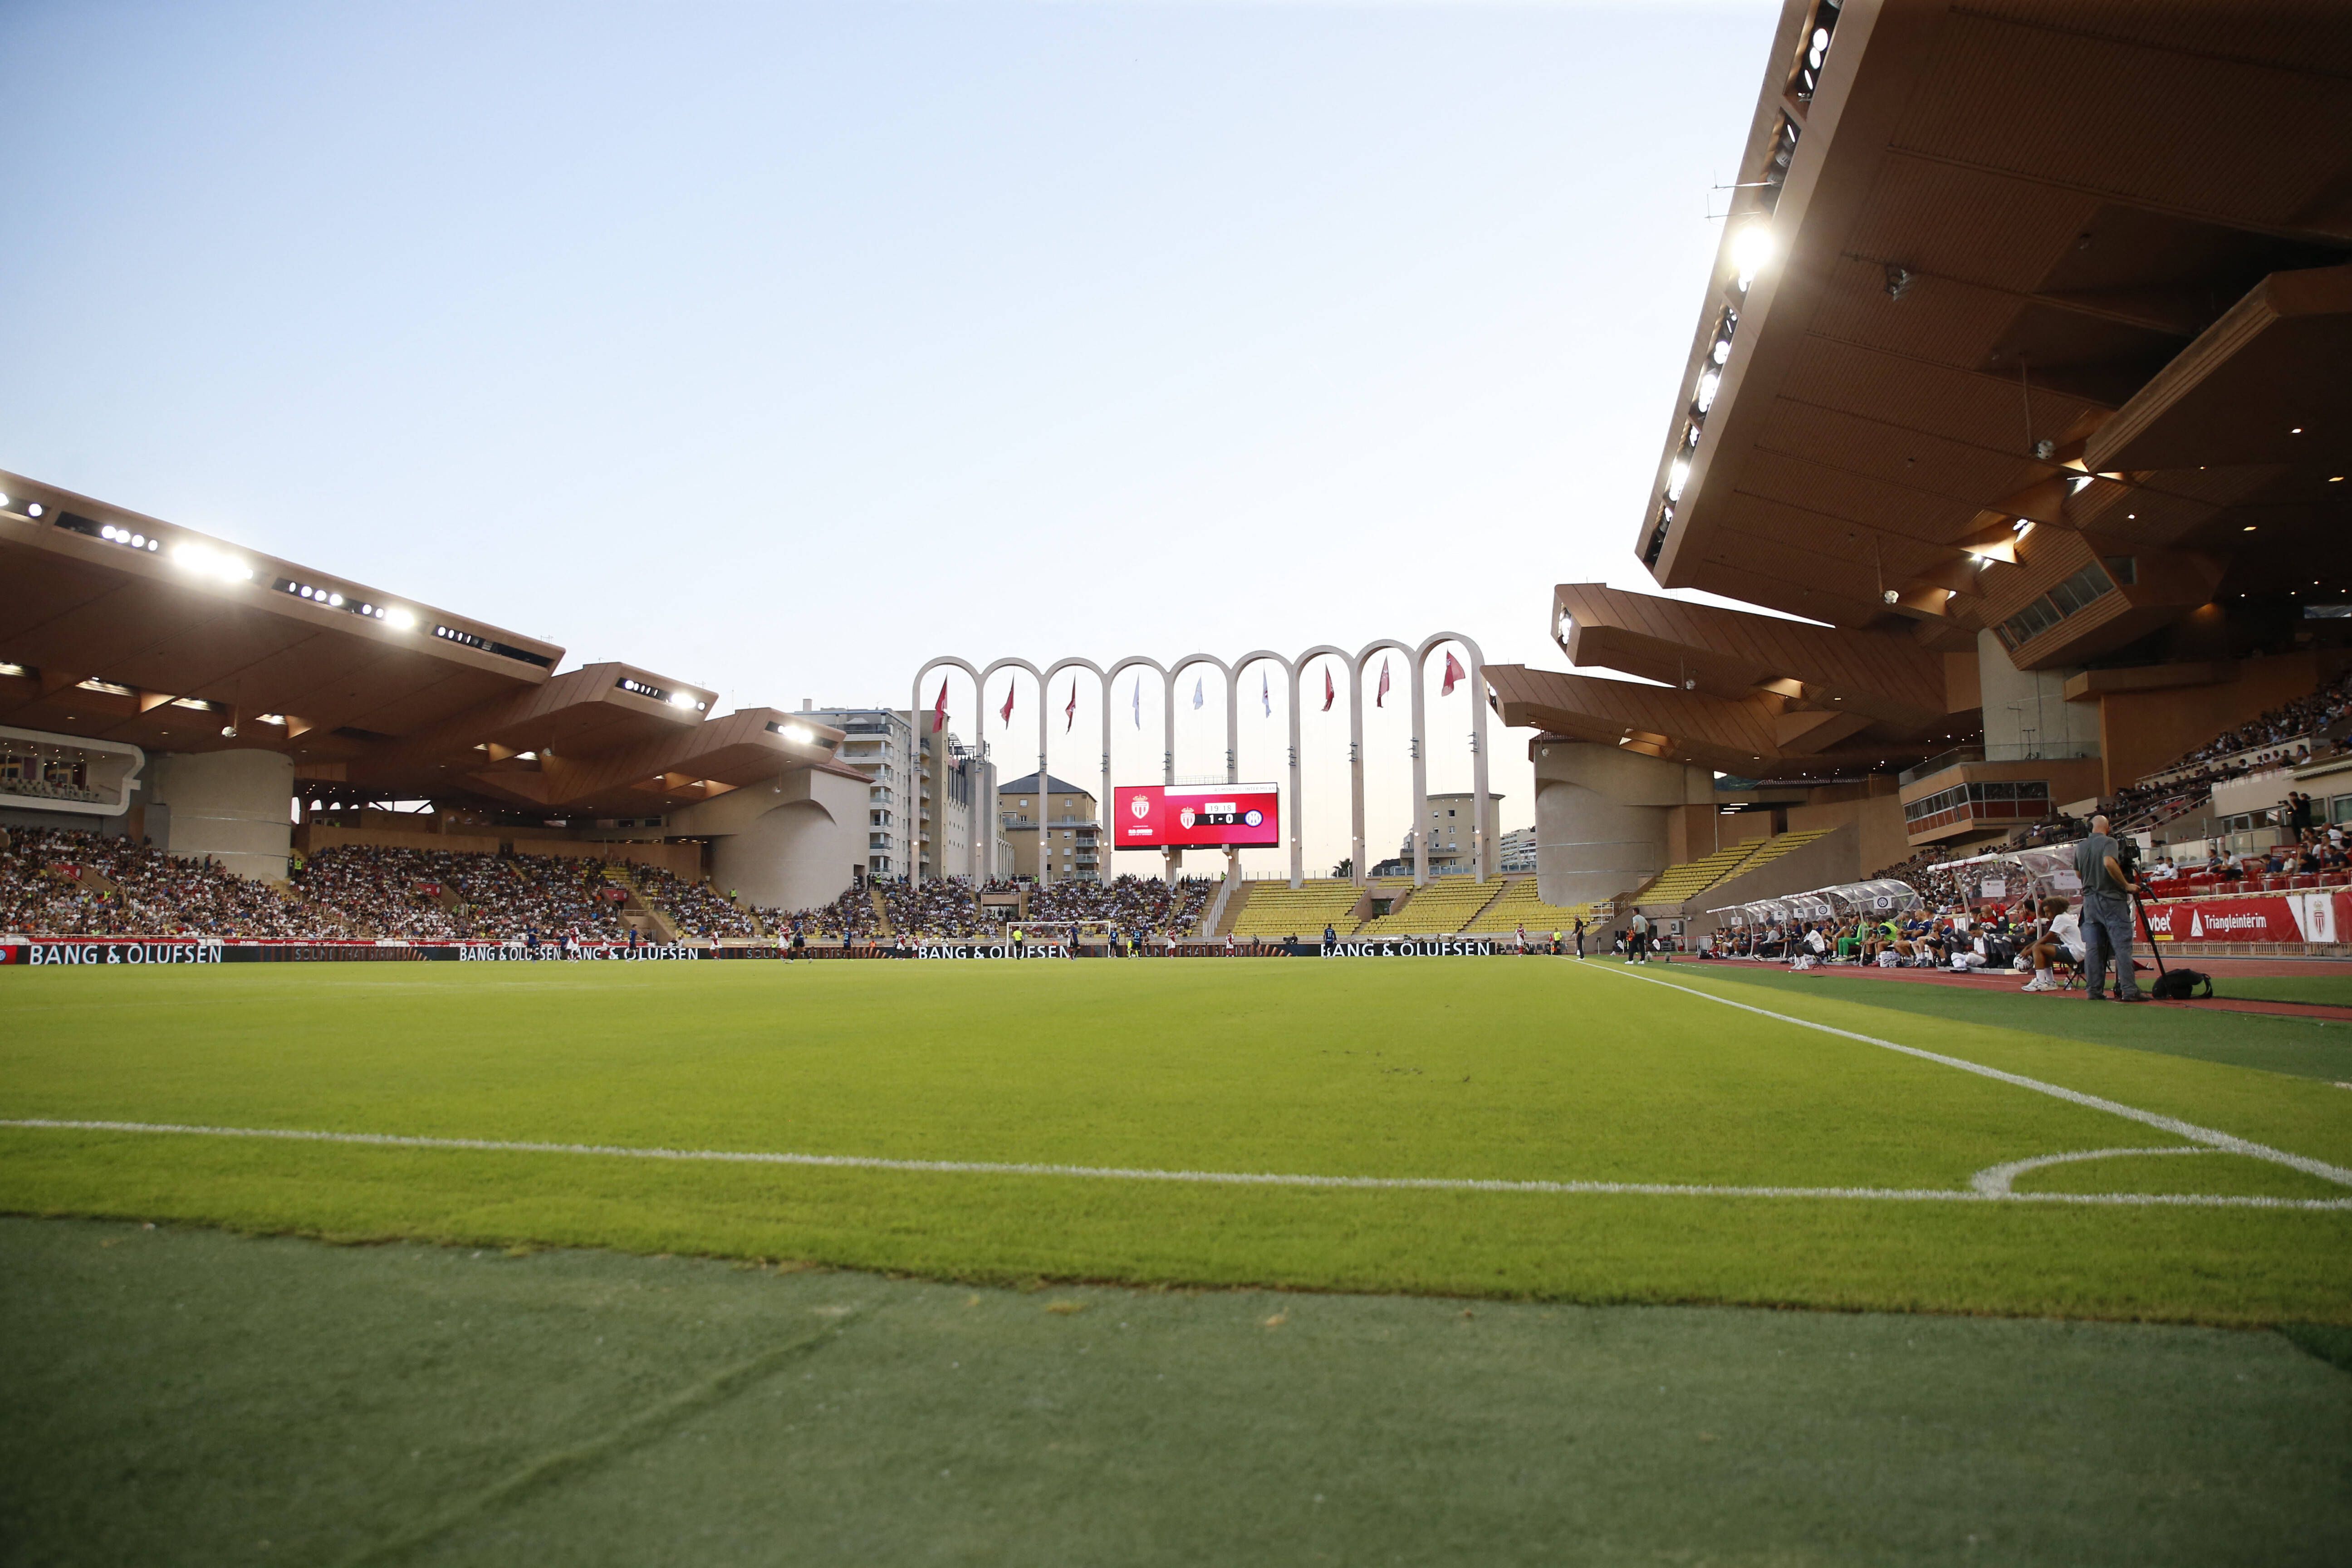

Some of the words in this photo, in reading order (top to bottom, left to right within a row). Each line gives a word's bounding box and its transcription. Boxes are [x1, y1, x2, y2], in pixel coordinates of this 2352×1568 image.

[2204, 912, 2267, 932] Triangleintérim
[29, 945, 98, 965] BANG
[107, 946, 121, 964] &
[127, 946, 221, 964] OLUFSEN
[460, 947, 495, 961] BANG
[499, 947, 507, 960] &
[609, 947, 619, 960] &
[623, 947, 698, 960] OLUFSEN
[918, 946, 966, 959] BANG
[974, 946, 985, 959] &
[990, 946, 1070, 959] OLUFSEN
[1321, 943, 1374, 957] BANG
[1382, 943, 1395, 956] &
[1400, 942, 1490, 956] OLUFSEN
